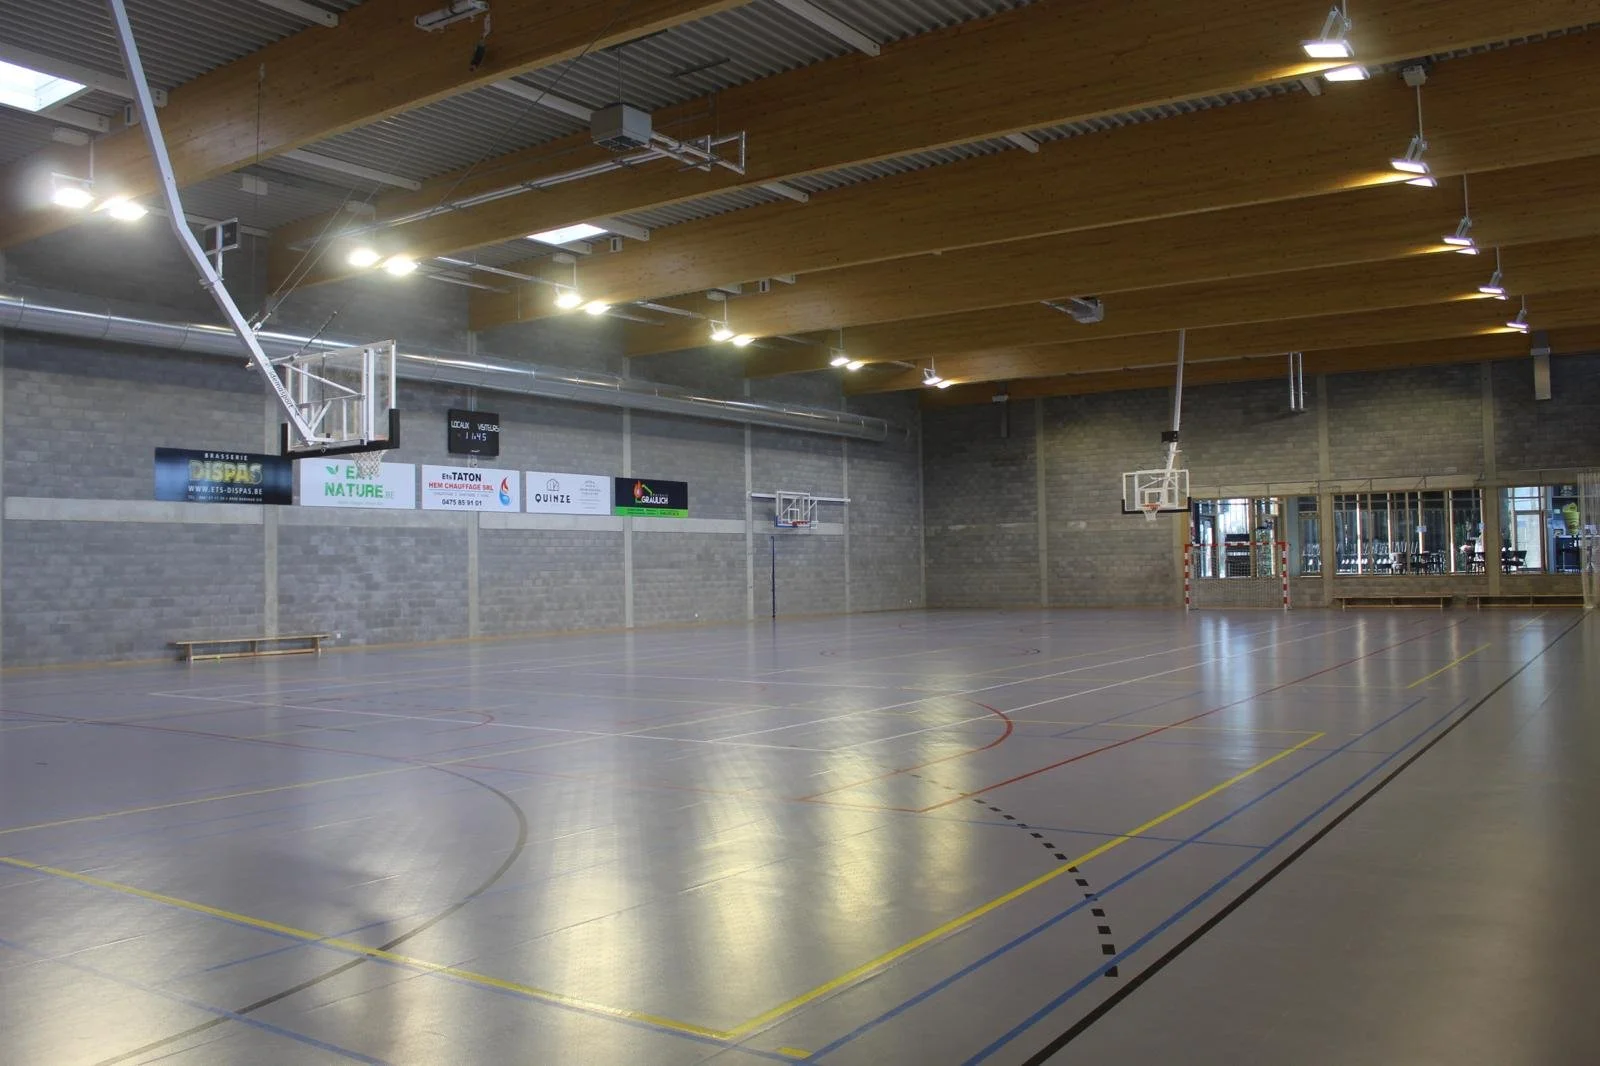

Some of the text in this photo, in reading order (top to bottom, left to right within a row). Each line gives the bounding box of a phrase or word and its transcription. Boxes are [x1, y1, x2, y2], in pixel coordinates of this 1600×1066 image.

[451, 420, 470, 429] LOCAUX
[204, 452, 249, 461] BRASSERIE
[452, 472, 482, 481] TATON
[188, 485, 263, 495] WWW.ETS-DISPAS.BE
[324, 482, 384, 498] NATURE
[441, 498, 457, 506] 0475
[535, 493, 571, 504] QUINZE
[641, 495, 669, 505] GRAULICH
